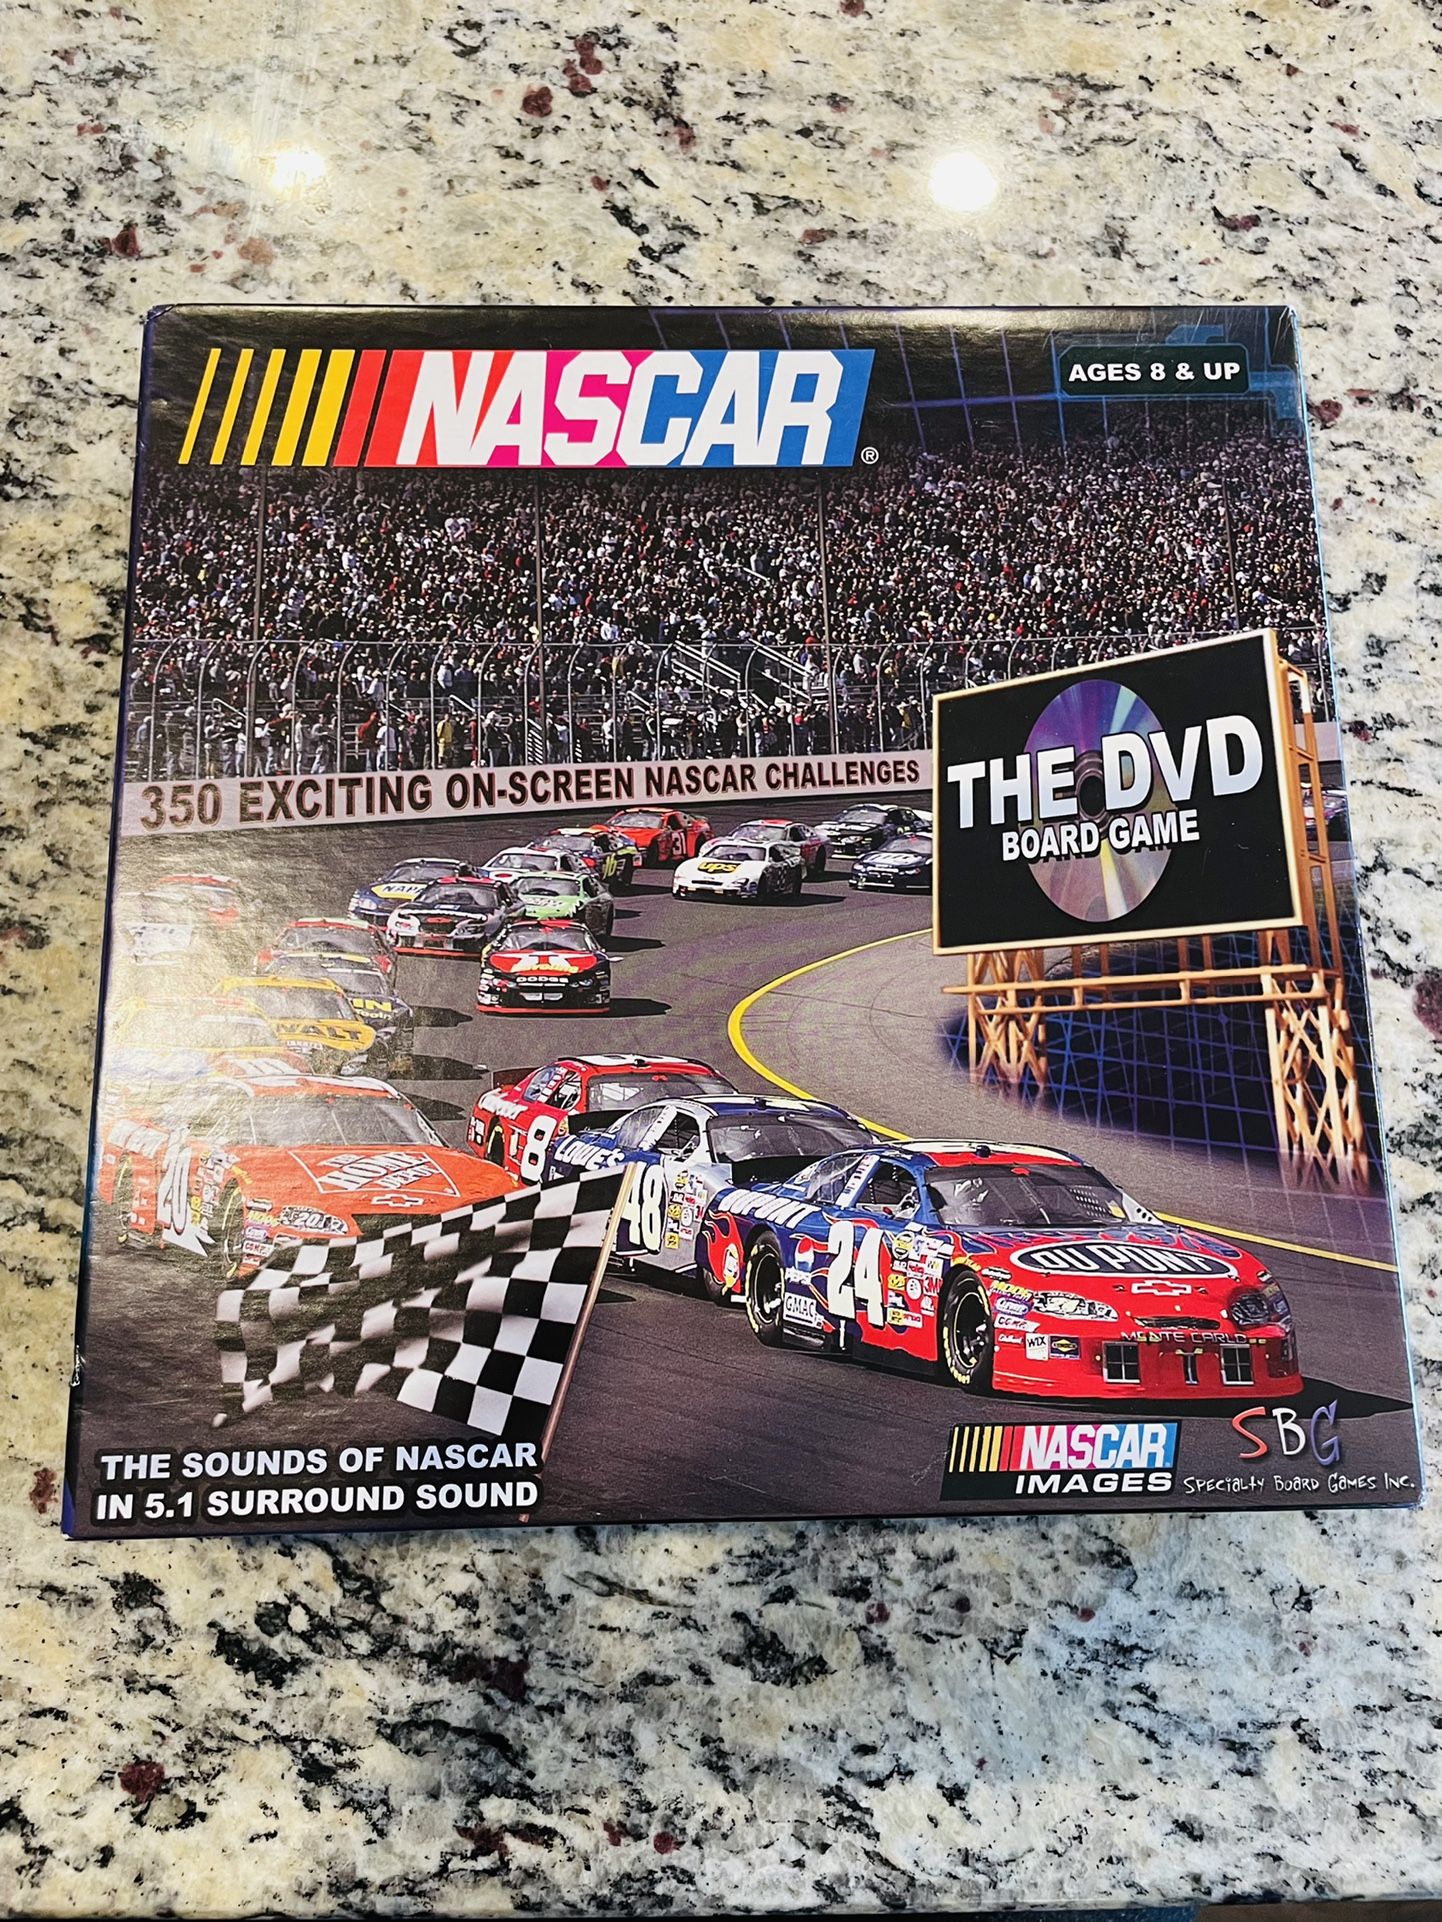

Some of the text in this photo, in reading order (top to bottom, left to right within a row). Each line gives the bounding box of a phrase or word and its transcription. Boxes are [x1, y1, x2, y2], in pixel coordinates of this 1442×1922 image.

[1068, 361, 1241, 382] AGES 8 & UP
[395, 349, 845, 467] NASCAR
[140, 759, 921, 832] 350 EXCITING ON-SCREEN NASCAR CHALLENGES
[946, 714, 1264, 830] THE DVD
[1001, 808, 1201, 863] BOARD GAME
[520, 1114, 558, 1182] 8
[827, 1220, 887, 1330] 24
[785, 1295, 815, 1318] GMAC
[1019, 1423, 1168, 1470] NASCAR
[1232, 1400, 1340, 1467] SBG
[101, 1442, 538, 1481] THE SOUNDS OF NASCAR
[1015, 1471, 1173, 1495] IMAGES
[96, 1480, 539, 1520] IN 5.1 SURROUND SOUND
